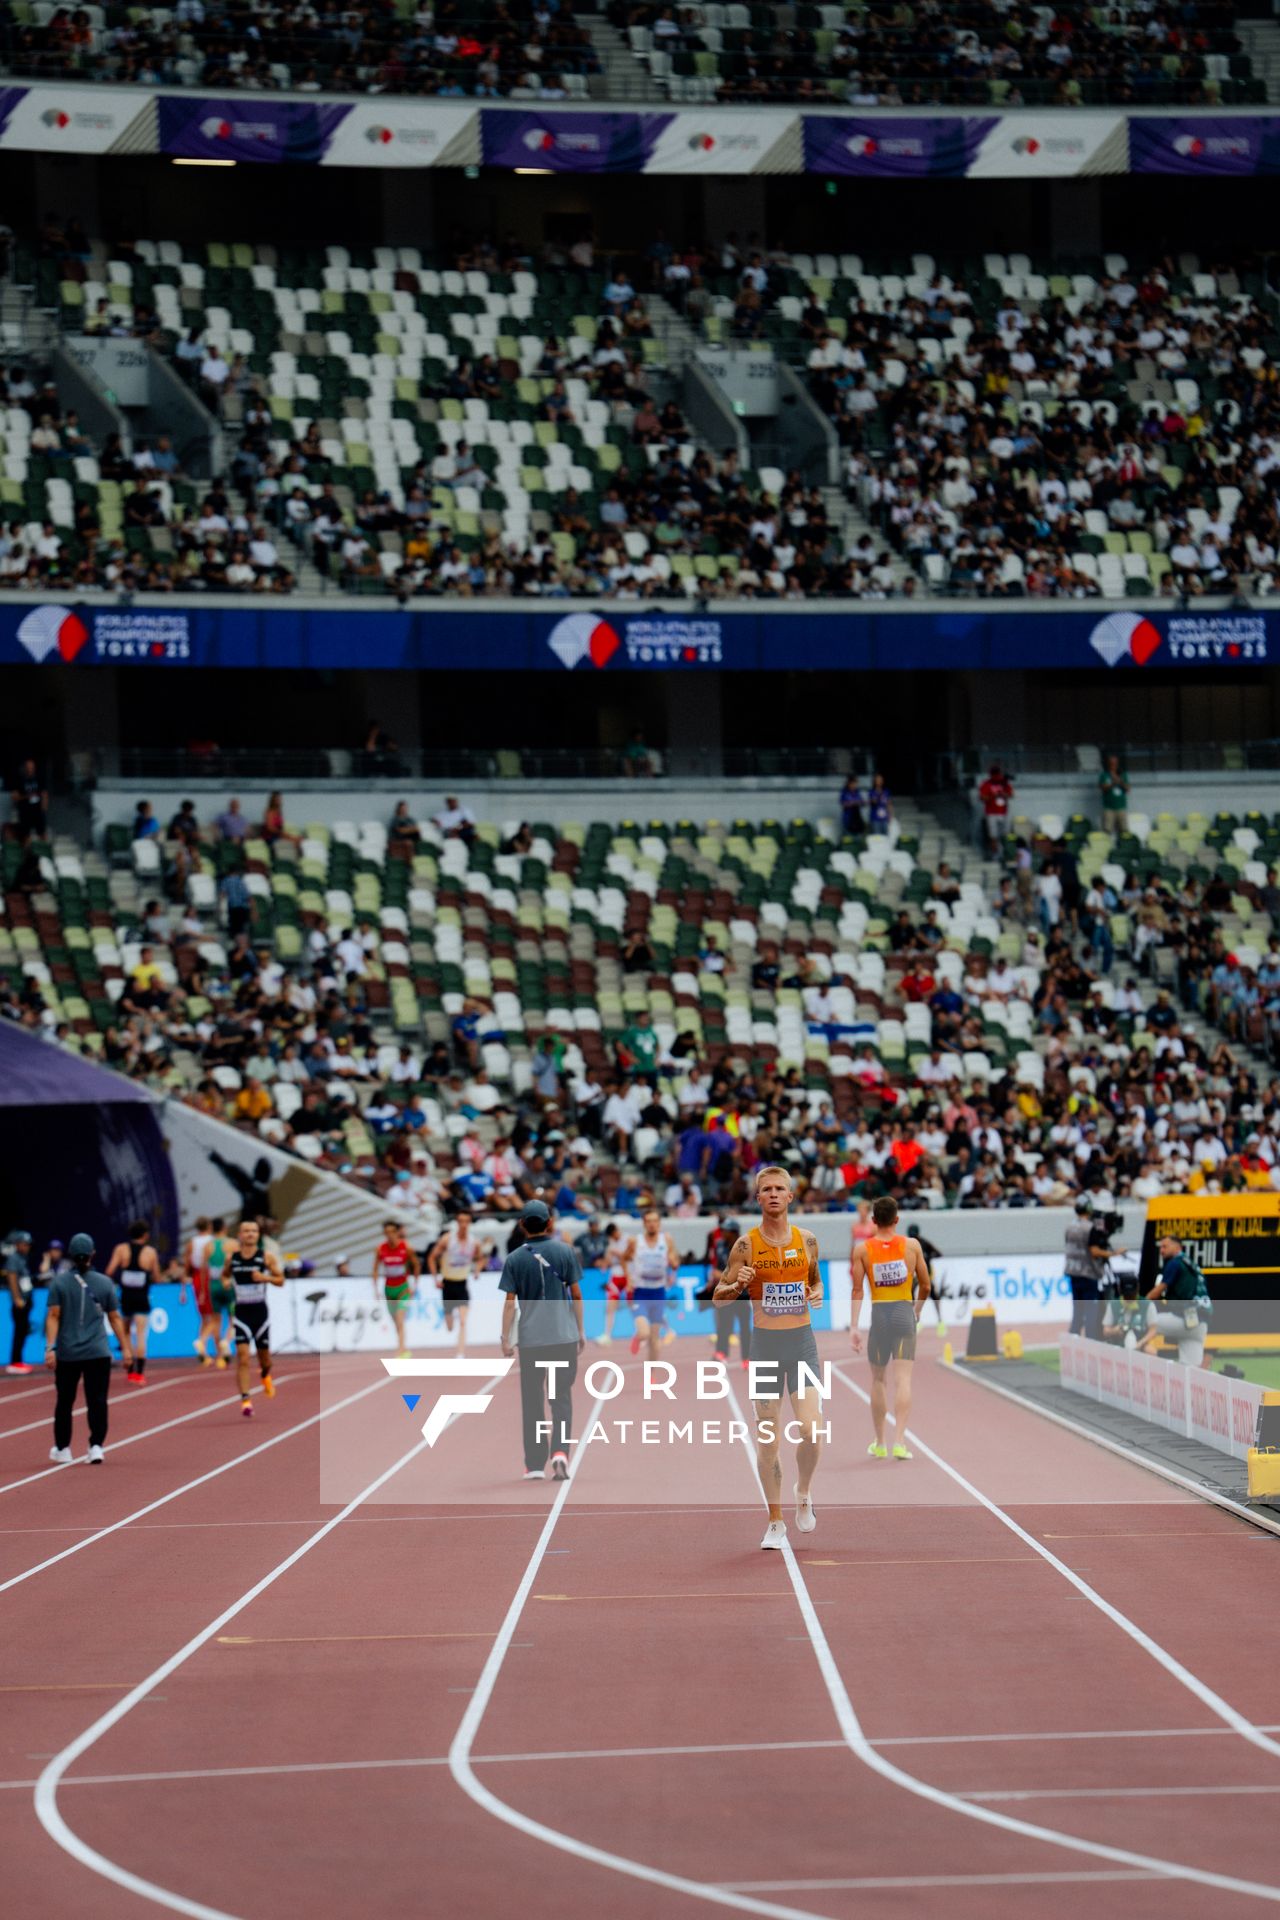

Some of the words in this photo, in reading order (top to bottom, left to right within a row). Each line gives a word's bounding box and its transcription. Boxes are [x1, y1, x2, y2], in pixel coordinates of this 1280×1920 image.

[1155, 1219, 1211, 1239] HAMMER
[1217, 1218, 1228, 1238] W
[756, 1259, 805, 1270] GERMANY
[883, 1262, 903, 1271] TDK
[881, 1271, 901, 1280] BEN
[775, 1283, 803, 1294] TDK
[987, 1267, 1072, 1307] Tokyo
[765, 1295, 804, 1306] FARKEN
[304, 1290, 383, 1344] Tokyo
